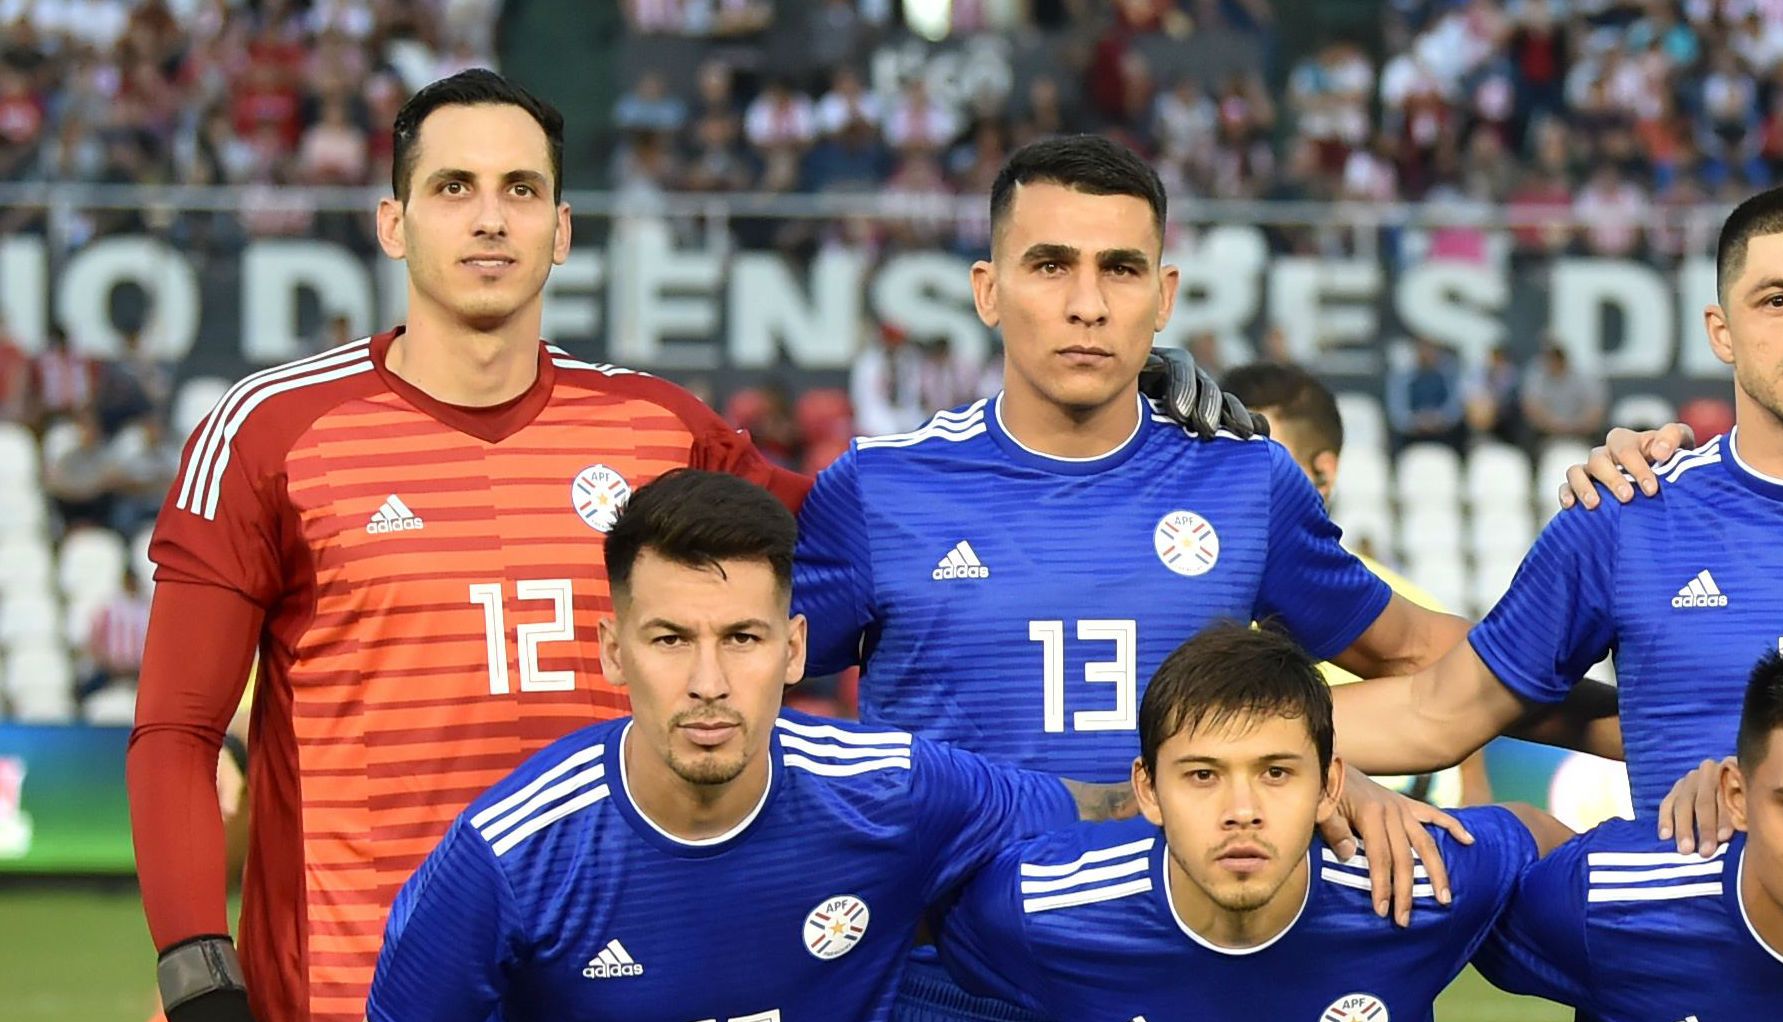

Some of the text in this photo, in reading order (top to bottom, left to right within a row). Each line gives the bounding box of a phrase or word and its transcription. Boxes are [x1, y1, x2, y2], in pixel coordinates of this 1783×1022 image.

[591, 471, 610, 482] APF
[366, 517, 424, 534] adidas
[1174, 515, 1194, 527] APF
[932, 565, 990, 580] adidas
[1671, 593, 1728, 608] adidas
[469, 578, 575, 695] 12
[1029, 619, 1137, 733] 13
[825, 899, 849, 914] APF
[582, 963, 644, 979] adidas
[1342, 997, 1366, 1010] APF
